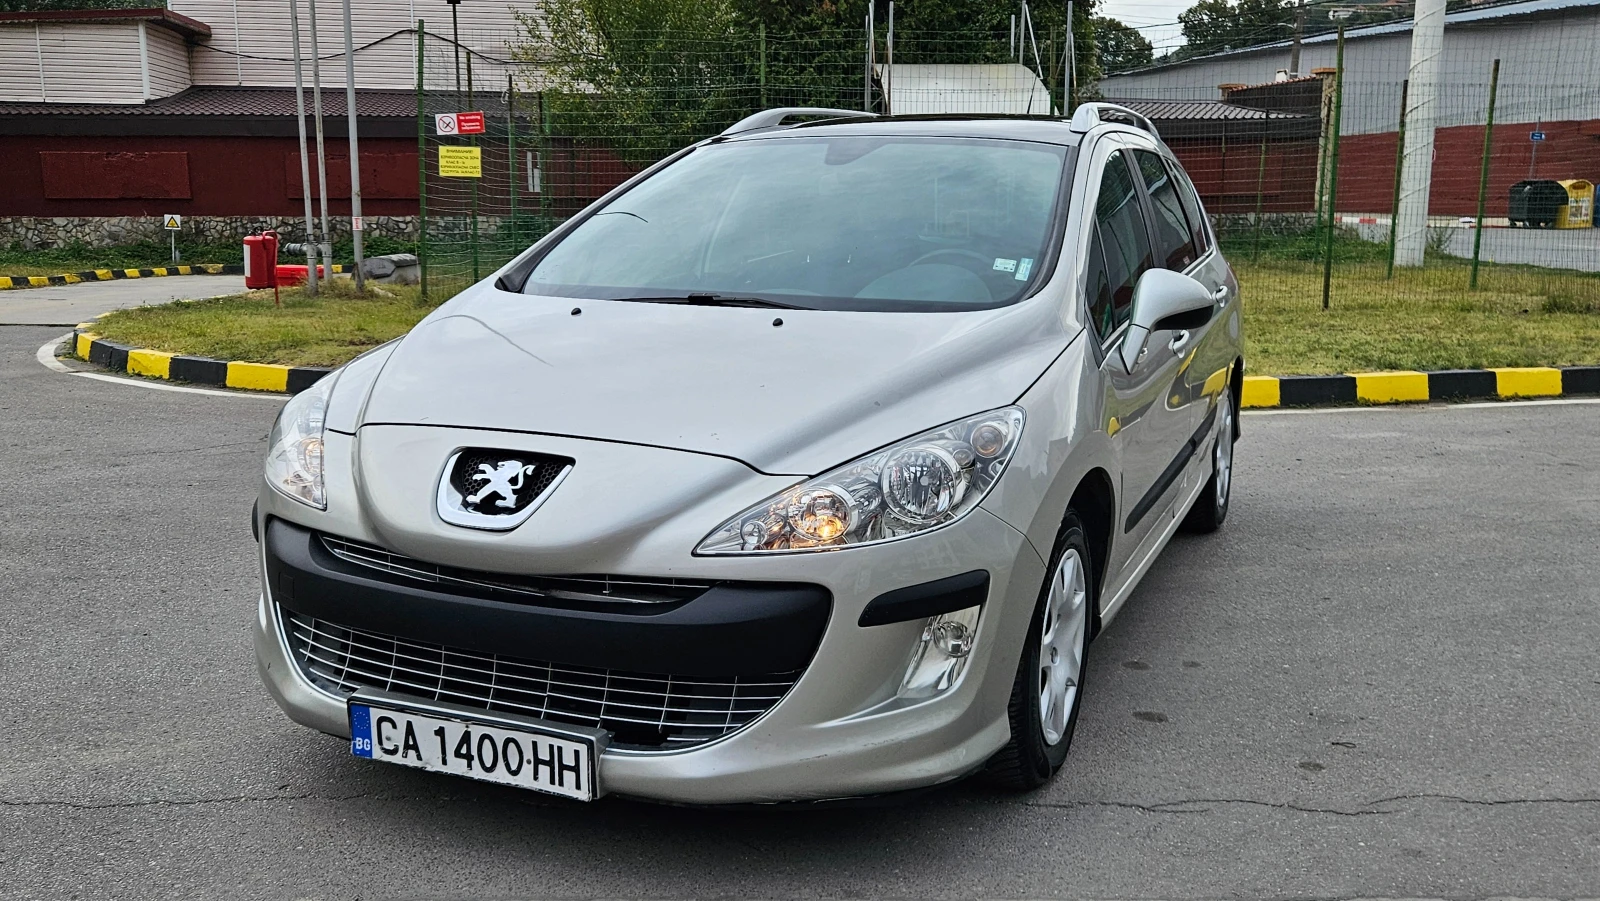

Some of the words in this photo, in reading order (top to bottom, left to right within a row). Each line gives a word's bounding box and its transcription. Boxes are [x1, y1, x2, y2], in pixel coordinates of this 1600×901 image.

[355, 737, 371, 751] BG
[376, 715, 423, 762] CA
[433, 725, 525, 777] 1400
[532, 740, 582, 791] HH
